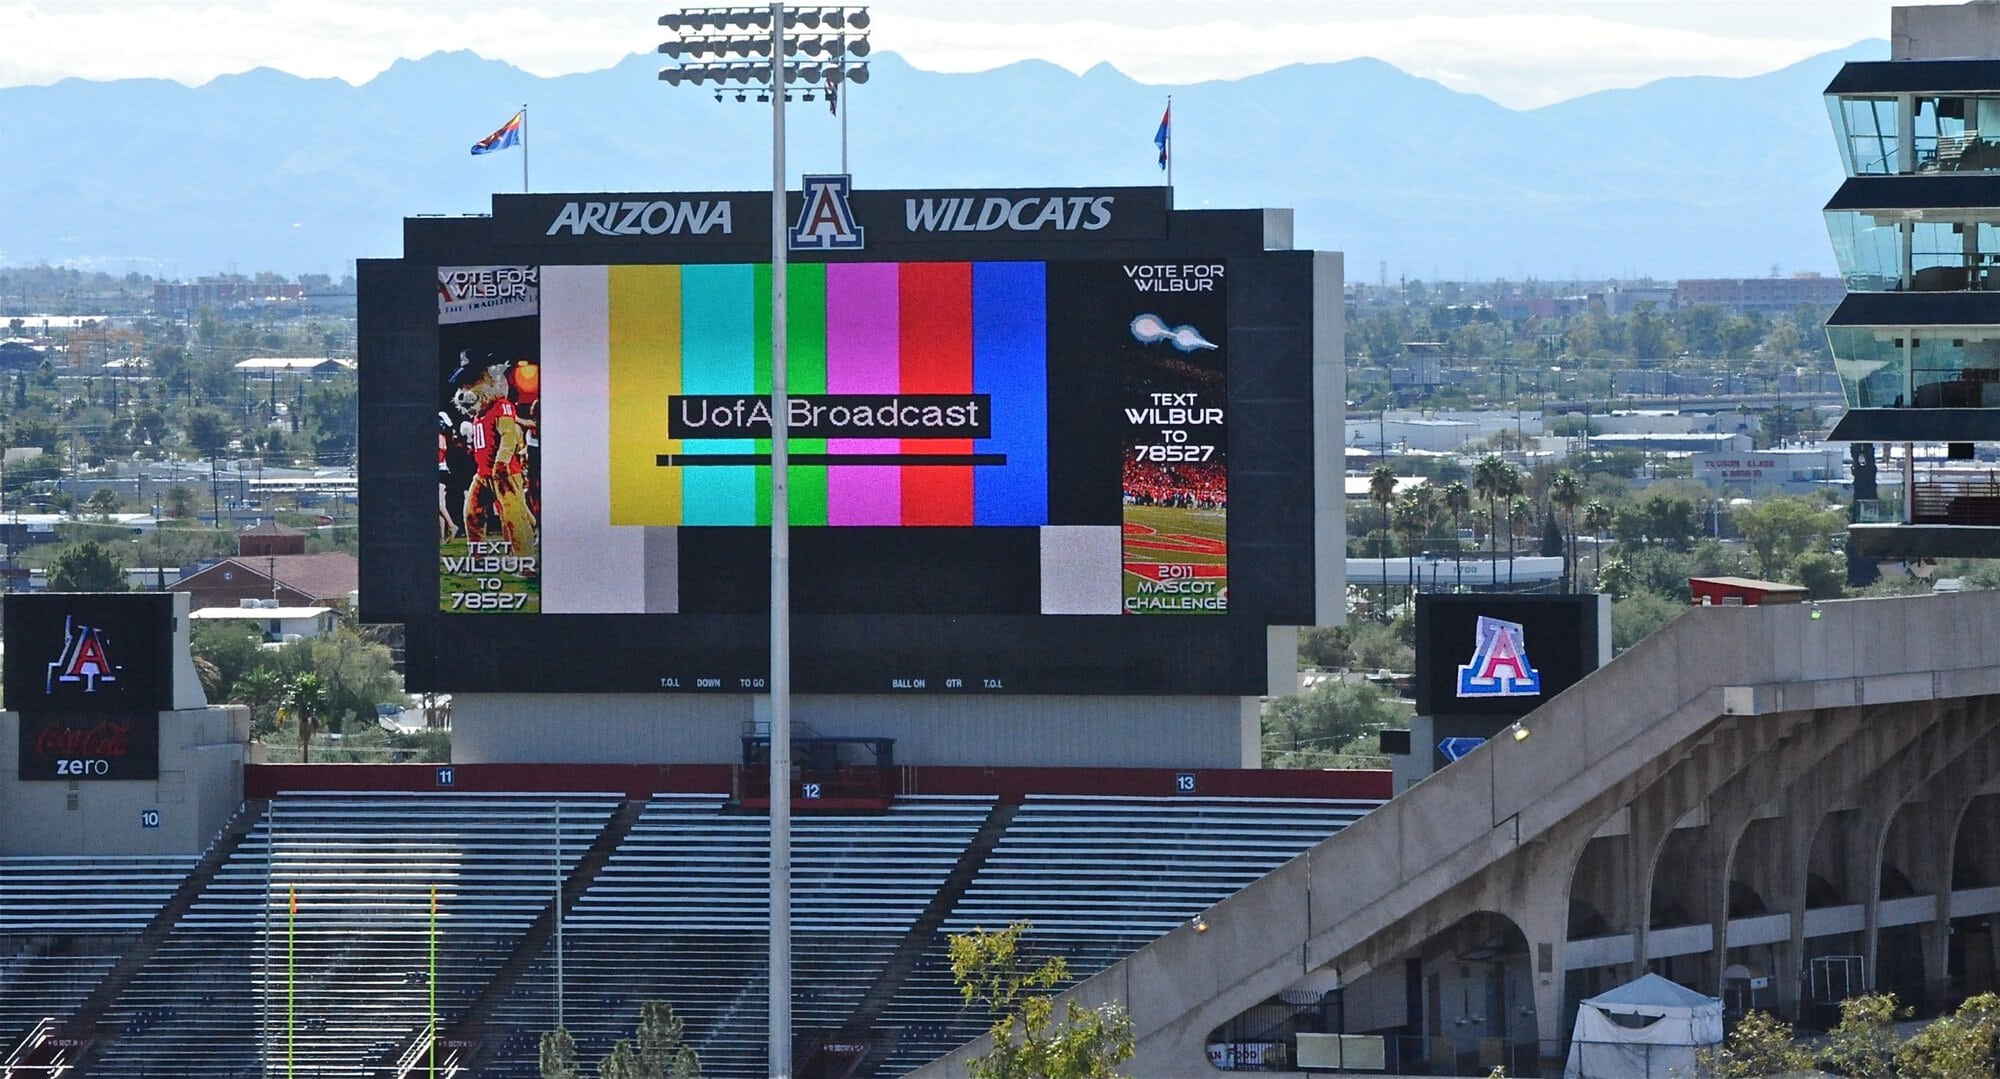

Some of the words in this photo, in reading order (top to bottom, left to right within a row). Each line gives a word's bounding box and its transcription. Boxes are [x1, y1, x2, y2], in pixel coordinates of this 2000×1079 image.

[546, 201, 732, 236] ARIZONA
[906, 196, 1114, 232] WILDCATS
[439, 270, 492, 284] VOTE
[496, 270, 537, 283] FOR
[1123, 265, 1177, 278] VOTE
[1182, 264, 1225, 278] FOR
[450, 284, 525, 297] WILBUR
[1134, 279, 1213, 292] WILBUR
[1151, 393, 1198, 406] TEXT
[682, 399, 773, 428] UofA
[787, 398, 979, 428] Broadcast
[1124, 408, 1224, 425] WILBUR
[1161, 430, 1188, 443] TO
[1134, 445, 1215, 462] 78527
[467, 541, 512, 554] TEXT
[442, 556, 536, 573] WILBUR
[1158, 565, 1193, 578] 2011
[477, 577, 502, 590] TO
[1137, 582, 1215, 593] MASCOT
[451, 592, 528, 609] 78527
[1125, 597, 1227, 609] CHALLENGE
[696, 679, 721, 687] DOWN
[740, 679, 751, 687] TO
[753, 679, 765, 687] GO
[892, 680, 912, 688] BALL
[913, 680, 925, 688] ON
[946, 679, 962, 688] QTR
[57, 759, 109, 775] zero
[439, 770, 452, 783] 11
[1178, 776, 1194, 790] 13
[802, 783, 820, 798] 12
[143, 812, 158, 826] 10
